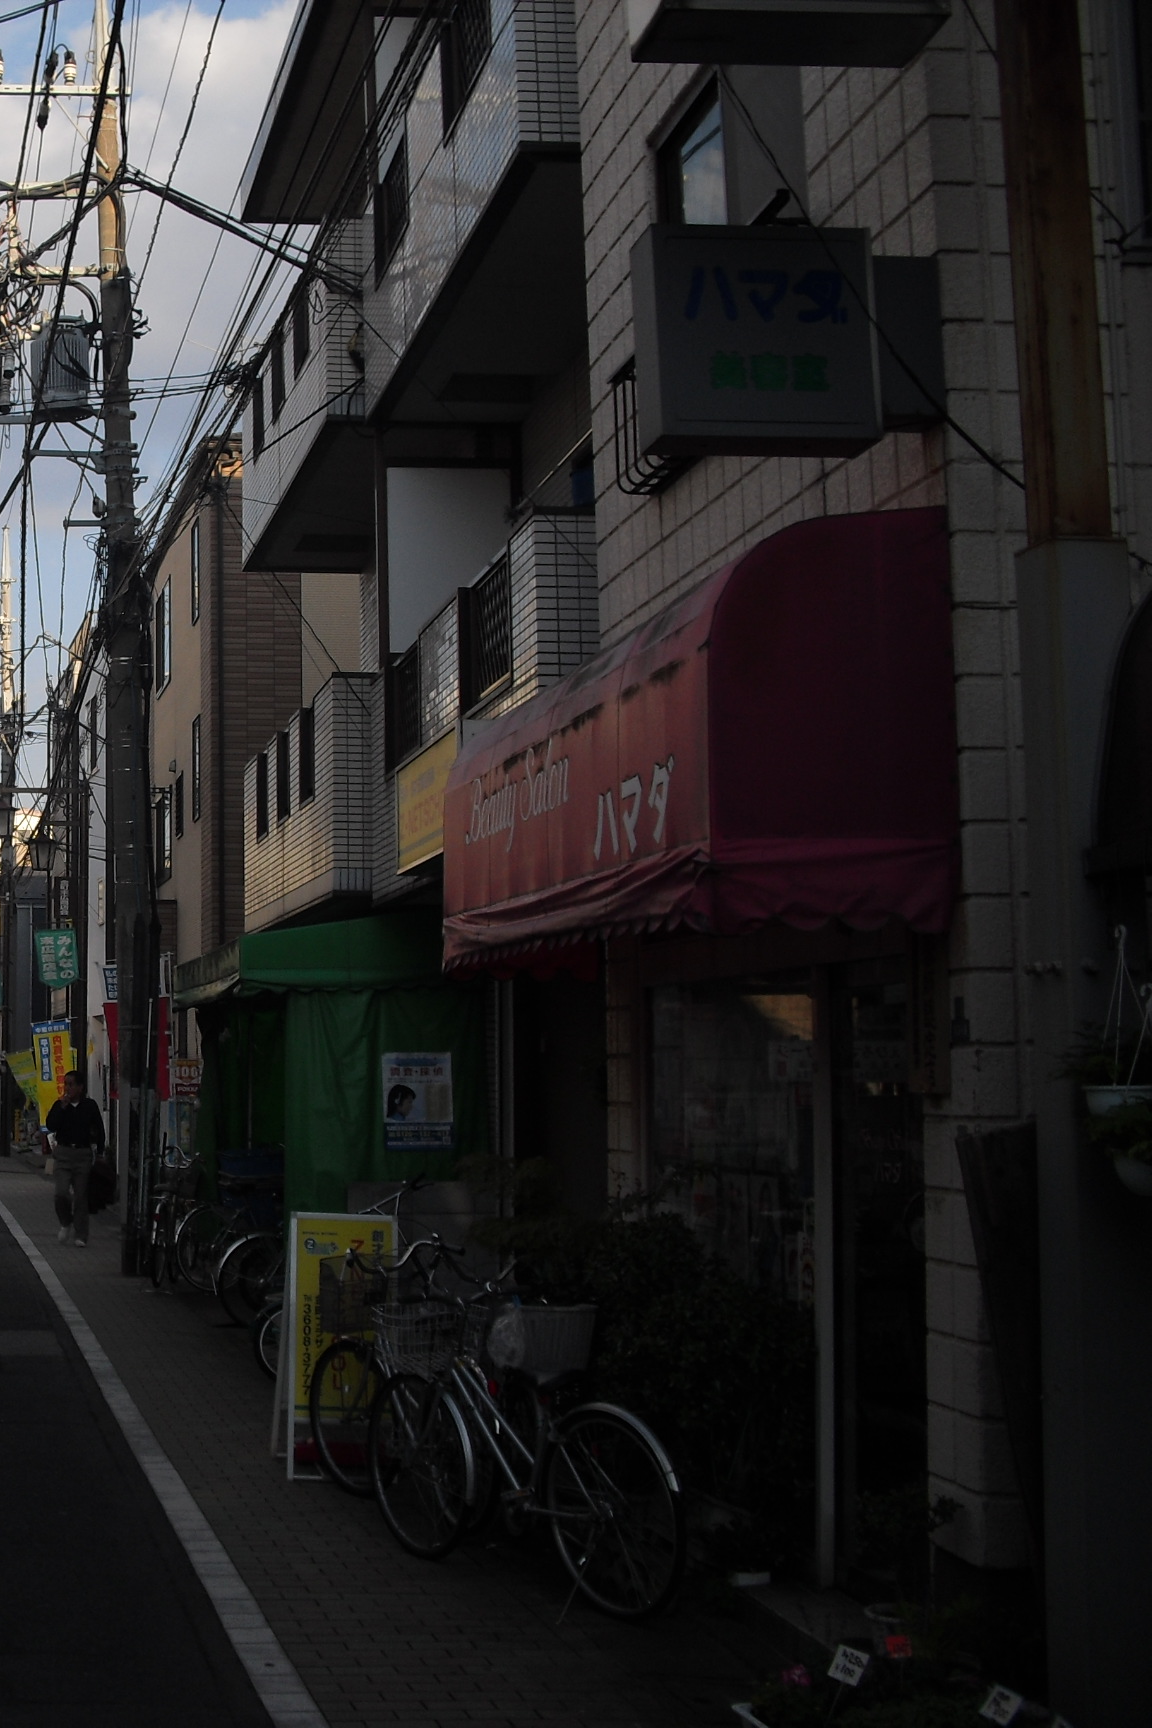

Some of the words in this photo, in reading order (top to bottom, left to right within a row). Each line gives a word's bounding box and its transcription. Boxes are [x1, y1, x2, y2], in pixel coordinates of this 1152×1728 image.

[684, 266, 848, 324] ハマダ
[710, 350, 831, 392] 美容室
[465, 772, 517, 853] Beauty
[519, 738, 569, 821] Salon
[593, 754, 675, 861] ハマダ
[56, 935, 75, 979] みんなの
